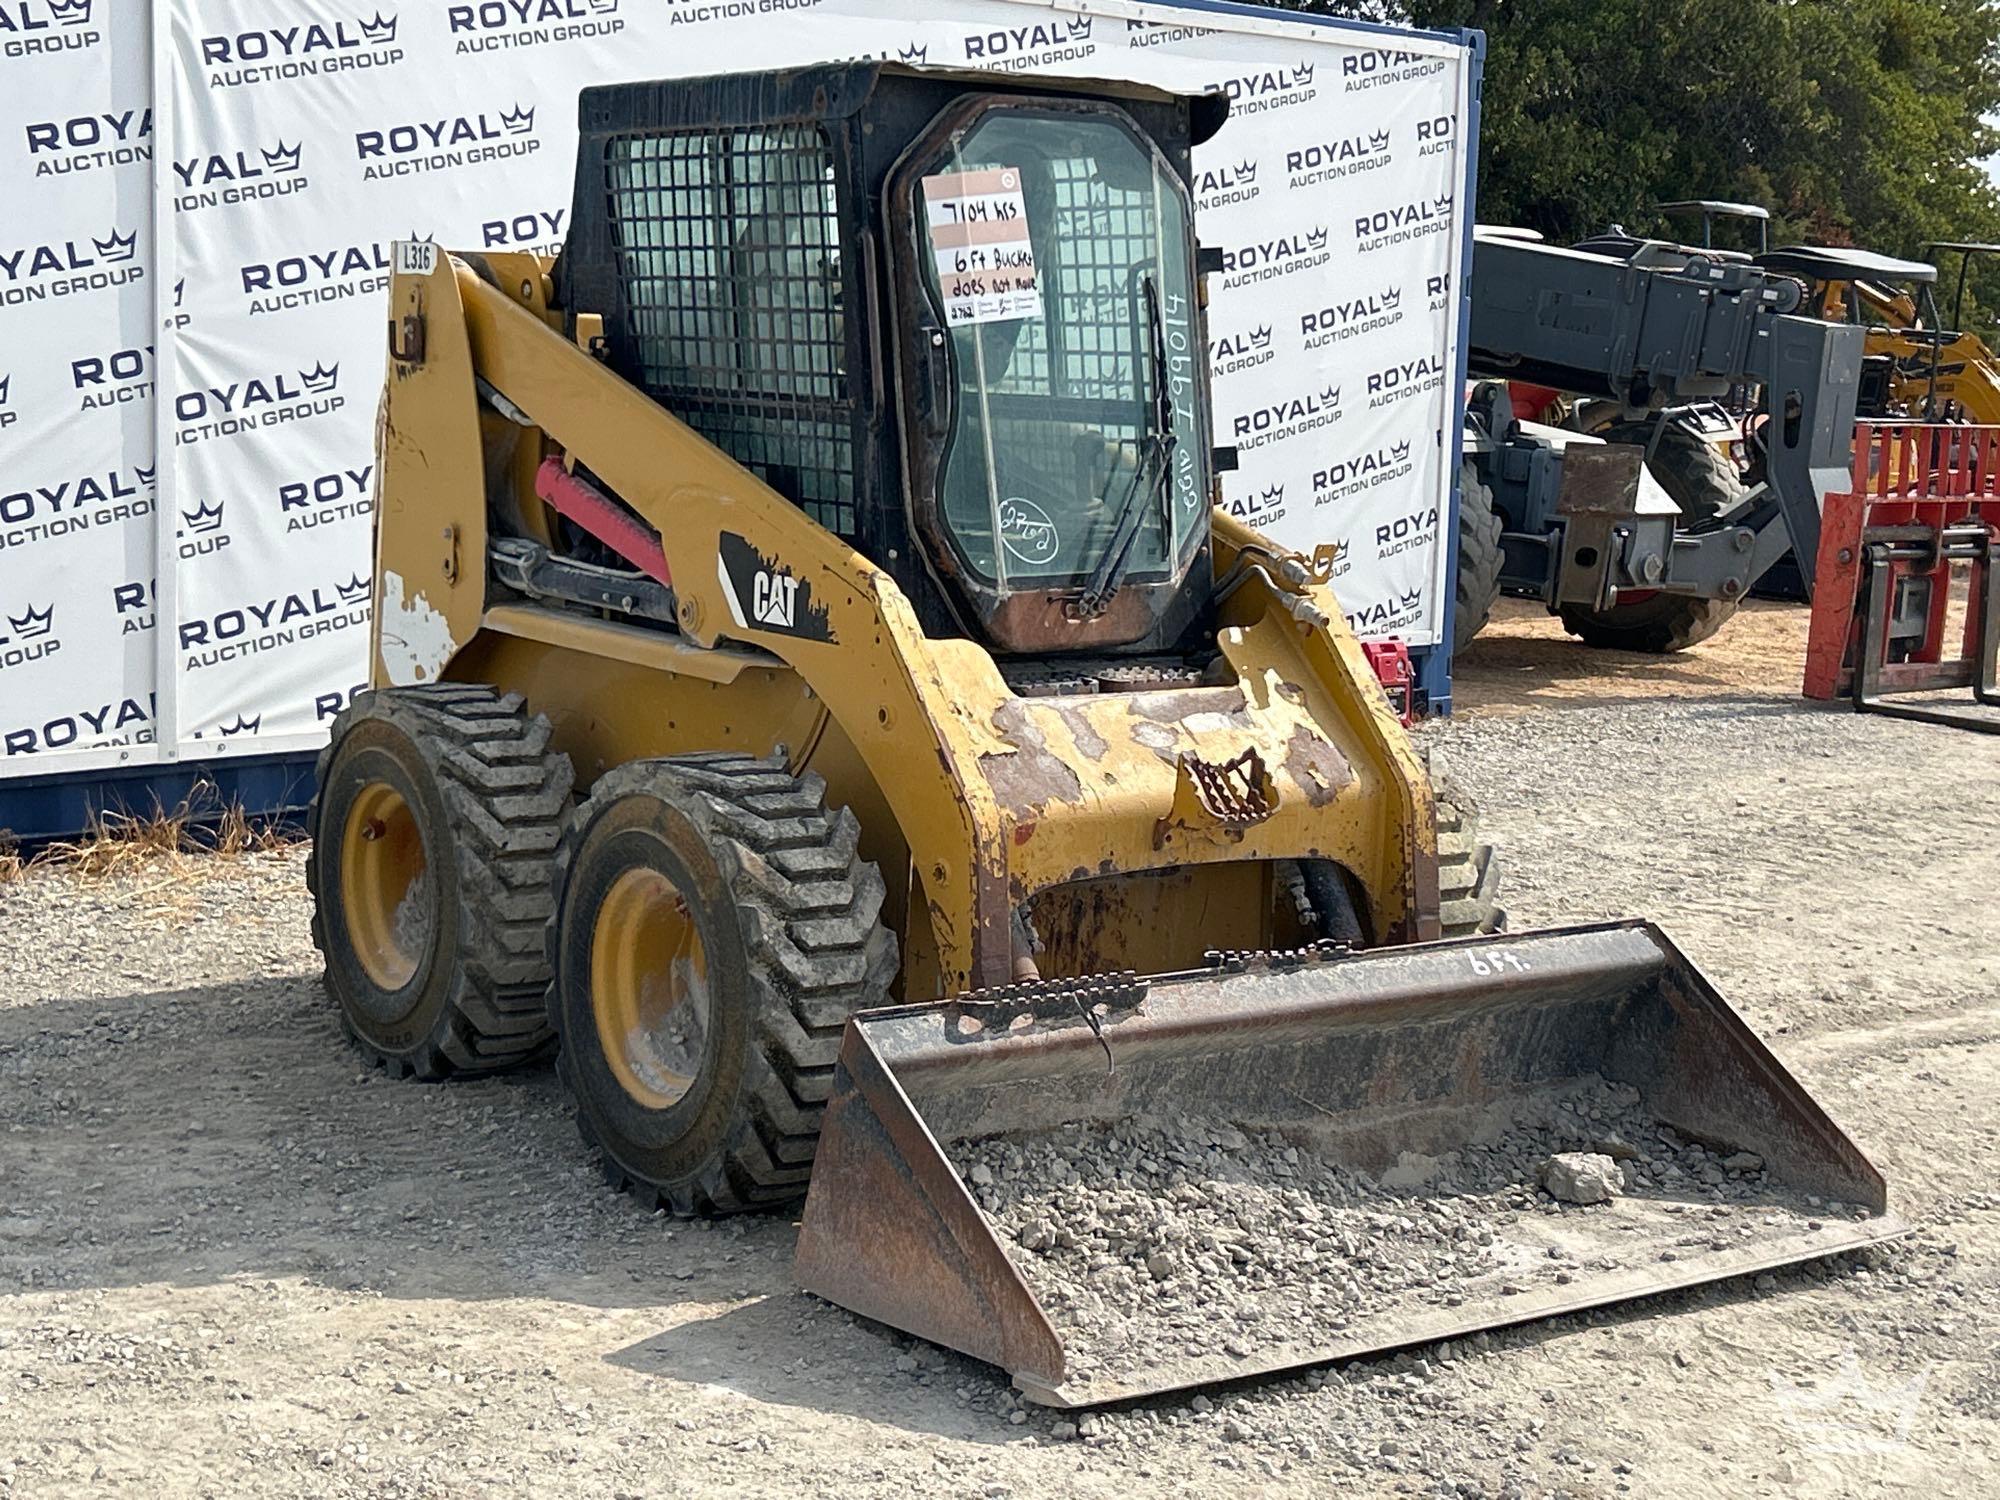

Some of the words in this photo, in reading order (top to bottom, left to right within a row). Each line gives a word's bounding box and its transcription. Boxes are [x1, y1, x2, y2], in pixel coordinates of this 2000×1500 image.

[449, 0, 587, 33] ROYAL
[670, 1, 756, 25] AUCTION
[4, 31, 100, 57] GROUP
[201, 22, 360, 65] ROYAL
[455, 28, 549, 55] AUCTION
[553, 20, 625, 41] GROUP
[964, 23, 1067, 59] ROYAL
[1042, 44, 1096, 65] GROUP
[1130, 26, 1193, 48] AUCTION
[210, 60, 318, 88] AUCTION
[322, 49, 404, 73] GROUP
[1345, 71, 1400, 93] AUCTION
[1402, 62, 1445, 80] GROUP
[1270, 89, 1316, 109] GROUP
[356, 114, 501, 160] ROYAL
[1286, 136, 1369, 173] ROYAL
[1419, 139, 1454, 157] AUCTI
[36, 145, 152, 177] AUCTION
[173, 151, 262, 188] YAL
[363, 150, 463, 182] AUCTION
[467, 139, 541, 164] GROUP
[1289, 167, 1346, 189] AUCTION
[1348, 155, 1392, 175] GROUP
[223, 177, 309, 204] GROUP
[1211, 186, 1260, 208] GROUP
[482, 209, 565, 248] ROY
[1355, 201, 1434, 238] ROYAL
[403, 244, 430, 271] L316
[1222, 235, 1307, 274] ROYAL
[1358, 229, 1411, 254] AUCTION
[0, 242, 94, 281] YAL
[241, 243, 390, 293] ROYAL
[955, 250, 967, 273] 6
[1223, 267, 1283, 291] AUCTION
[1285, 252, 1330, 274] GROUP
[51, 266, 144, 297] GROUP
[249, 282, 355, 315] AUCTION
[1301, 296, 1382, 335] ROYAL
[1304, 326, 1359, 351] AUCTION
[1361, 311, 1403, 333] GROUP
[1226, 350, 1274, 373] GROUP
[1367, 355, 1443, 395] ROYAL
[175, 374, 301, 421] OYAL
[262, 396, 345, 427] GROUP
[1369, 382, 1421, 410] AUCTION
[1234, 395, 1320, 437] ROYAL
[1237, 426, 1296, 452] AUCTION
[1298, 410, 1342, 433] GROUP
[279, 465, 374, 512] ROY
[1312, 453, 1391, 491] ROYAL
[1314, 479, 1369, 507] AUCTION
[1371, 463, 1412, 486] GROUP
[0, 471, 137, 523] OYAL
[1376, 507, 1438, 546] ROYA
[1378, 531, 1433, 560] AUCTION
[753, 570, 799, 628] CAT
[179, 589, 337, 651] ROYAL
[1381, 610, 1423, 634] GROUP
[186, 629, 295, 671] AUCTION
